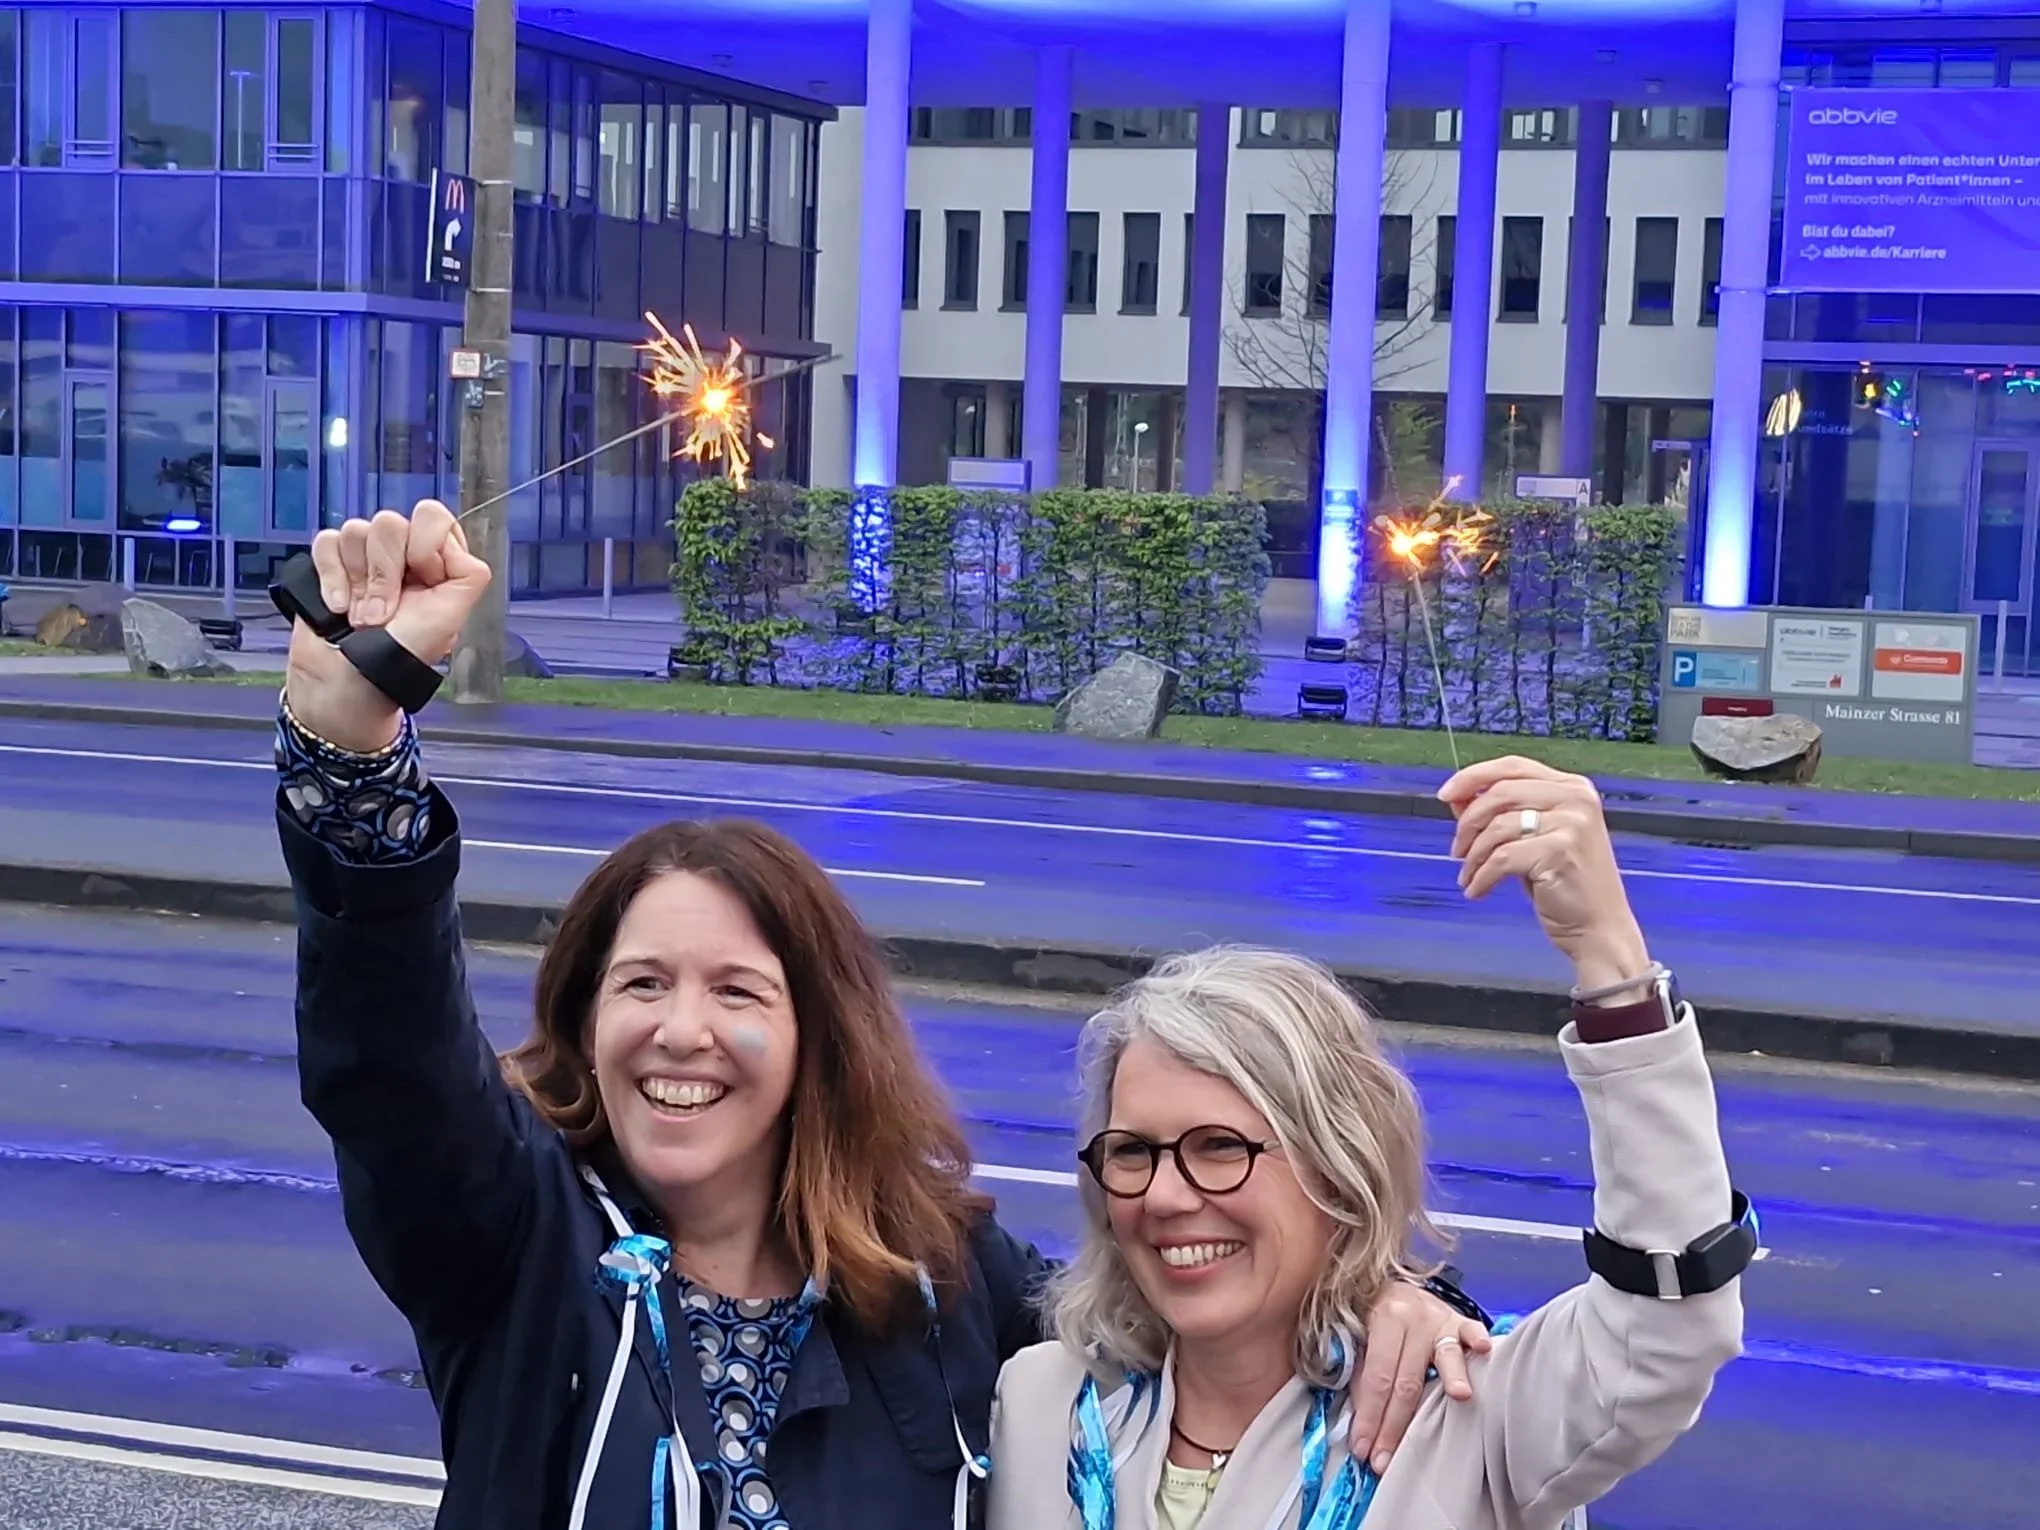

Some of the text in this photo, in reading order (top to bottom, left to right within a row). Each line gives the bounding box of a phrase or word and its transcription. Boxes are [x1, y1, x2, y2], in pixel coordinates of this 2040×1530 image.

[1808, 106, 1898, 125] abbvie
[1806, 153, 1832, 166] Wir
[1835, 154, 1895, 166] machen
[1898, 154, 1939, 167] einen
[1942, 154, 1995, 167] echten
[1827, 173, 1873, 186] Leben
[1875, 175, 1903, 186] von
[1804, 193, 1829, 205] mit
[1831, 193, 1914, 206] innovativen
[1917, 193, 2014, 207] Arzneimitteln
[1802, 224, 1896, 238] Bist du dabei?
[1823, 244, 1947, 260] abbvie.de/Karriere
[1675, 655, 1694, 684] P
[1825, 703, 1960, 724] Mainzer Strasse 81
